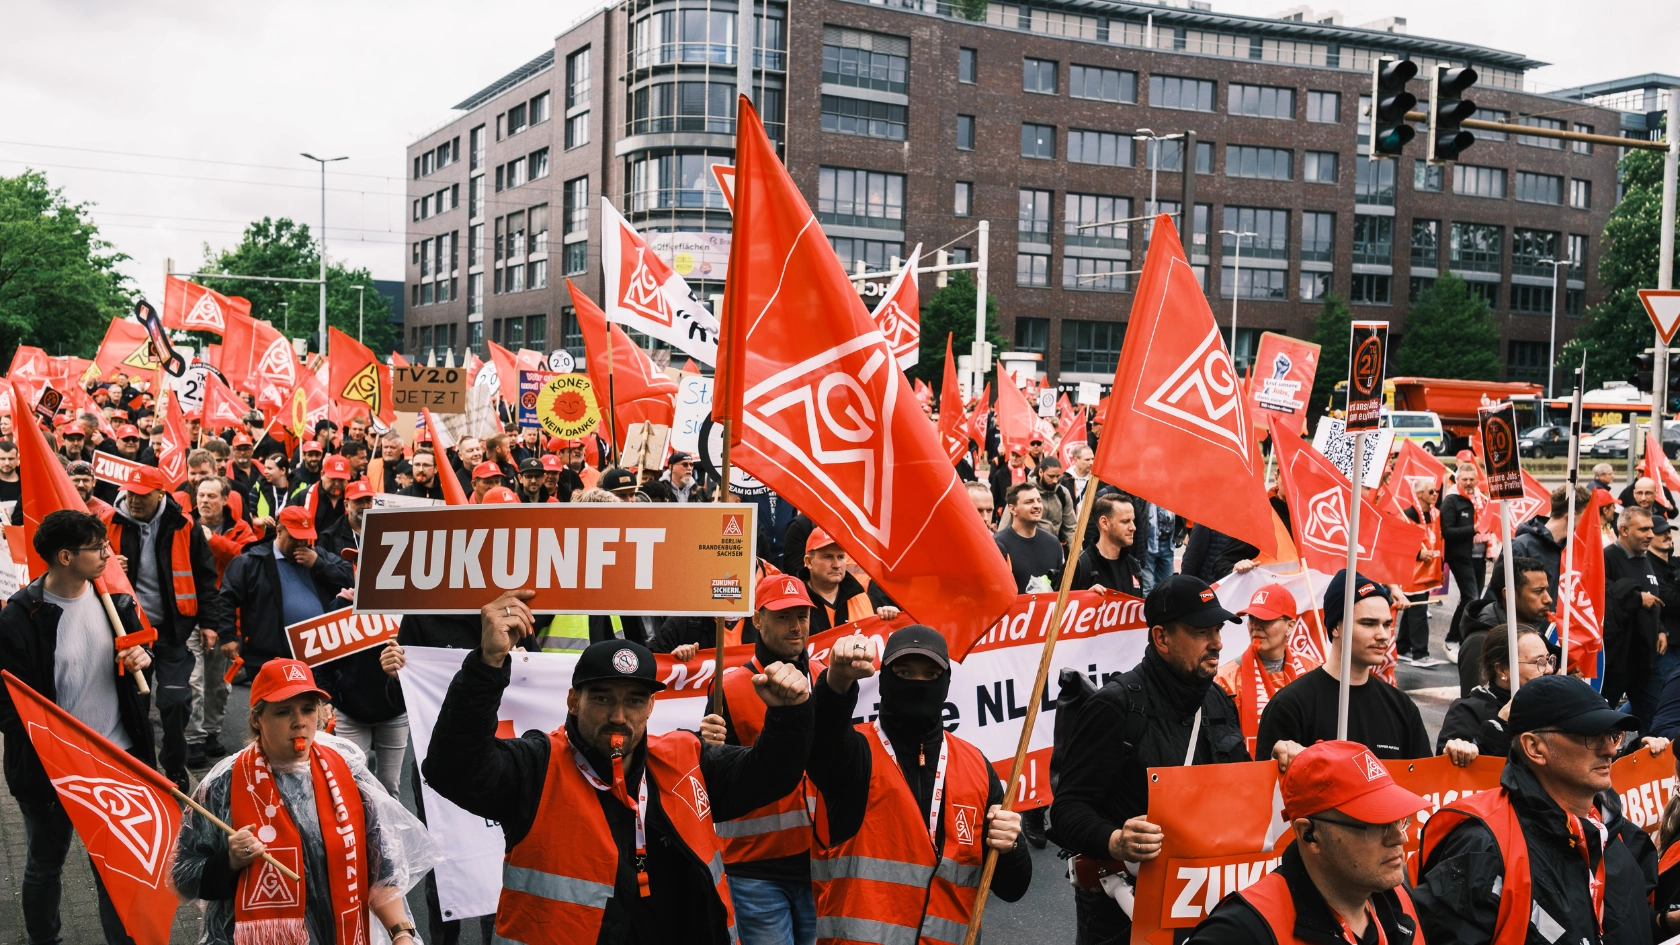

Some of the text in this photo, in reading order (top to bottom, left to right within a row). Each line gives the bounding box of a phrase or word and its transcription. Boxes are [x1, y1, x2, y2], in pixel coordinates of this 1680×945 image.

[552, 357, 571, 368] 2.0
[396, 368, 459, 384] TV2.0
[549, 377, 590, 392] KONE?
[395, 390, 459, 404] JETZT
[542, 416, 596, 437] NEIN DANKE
[375, 527, 667, 590] ZUKUNFT
